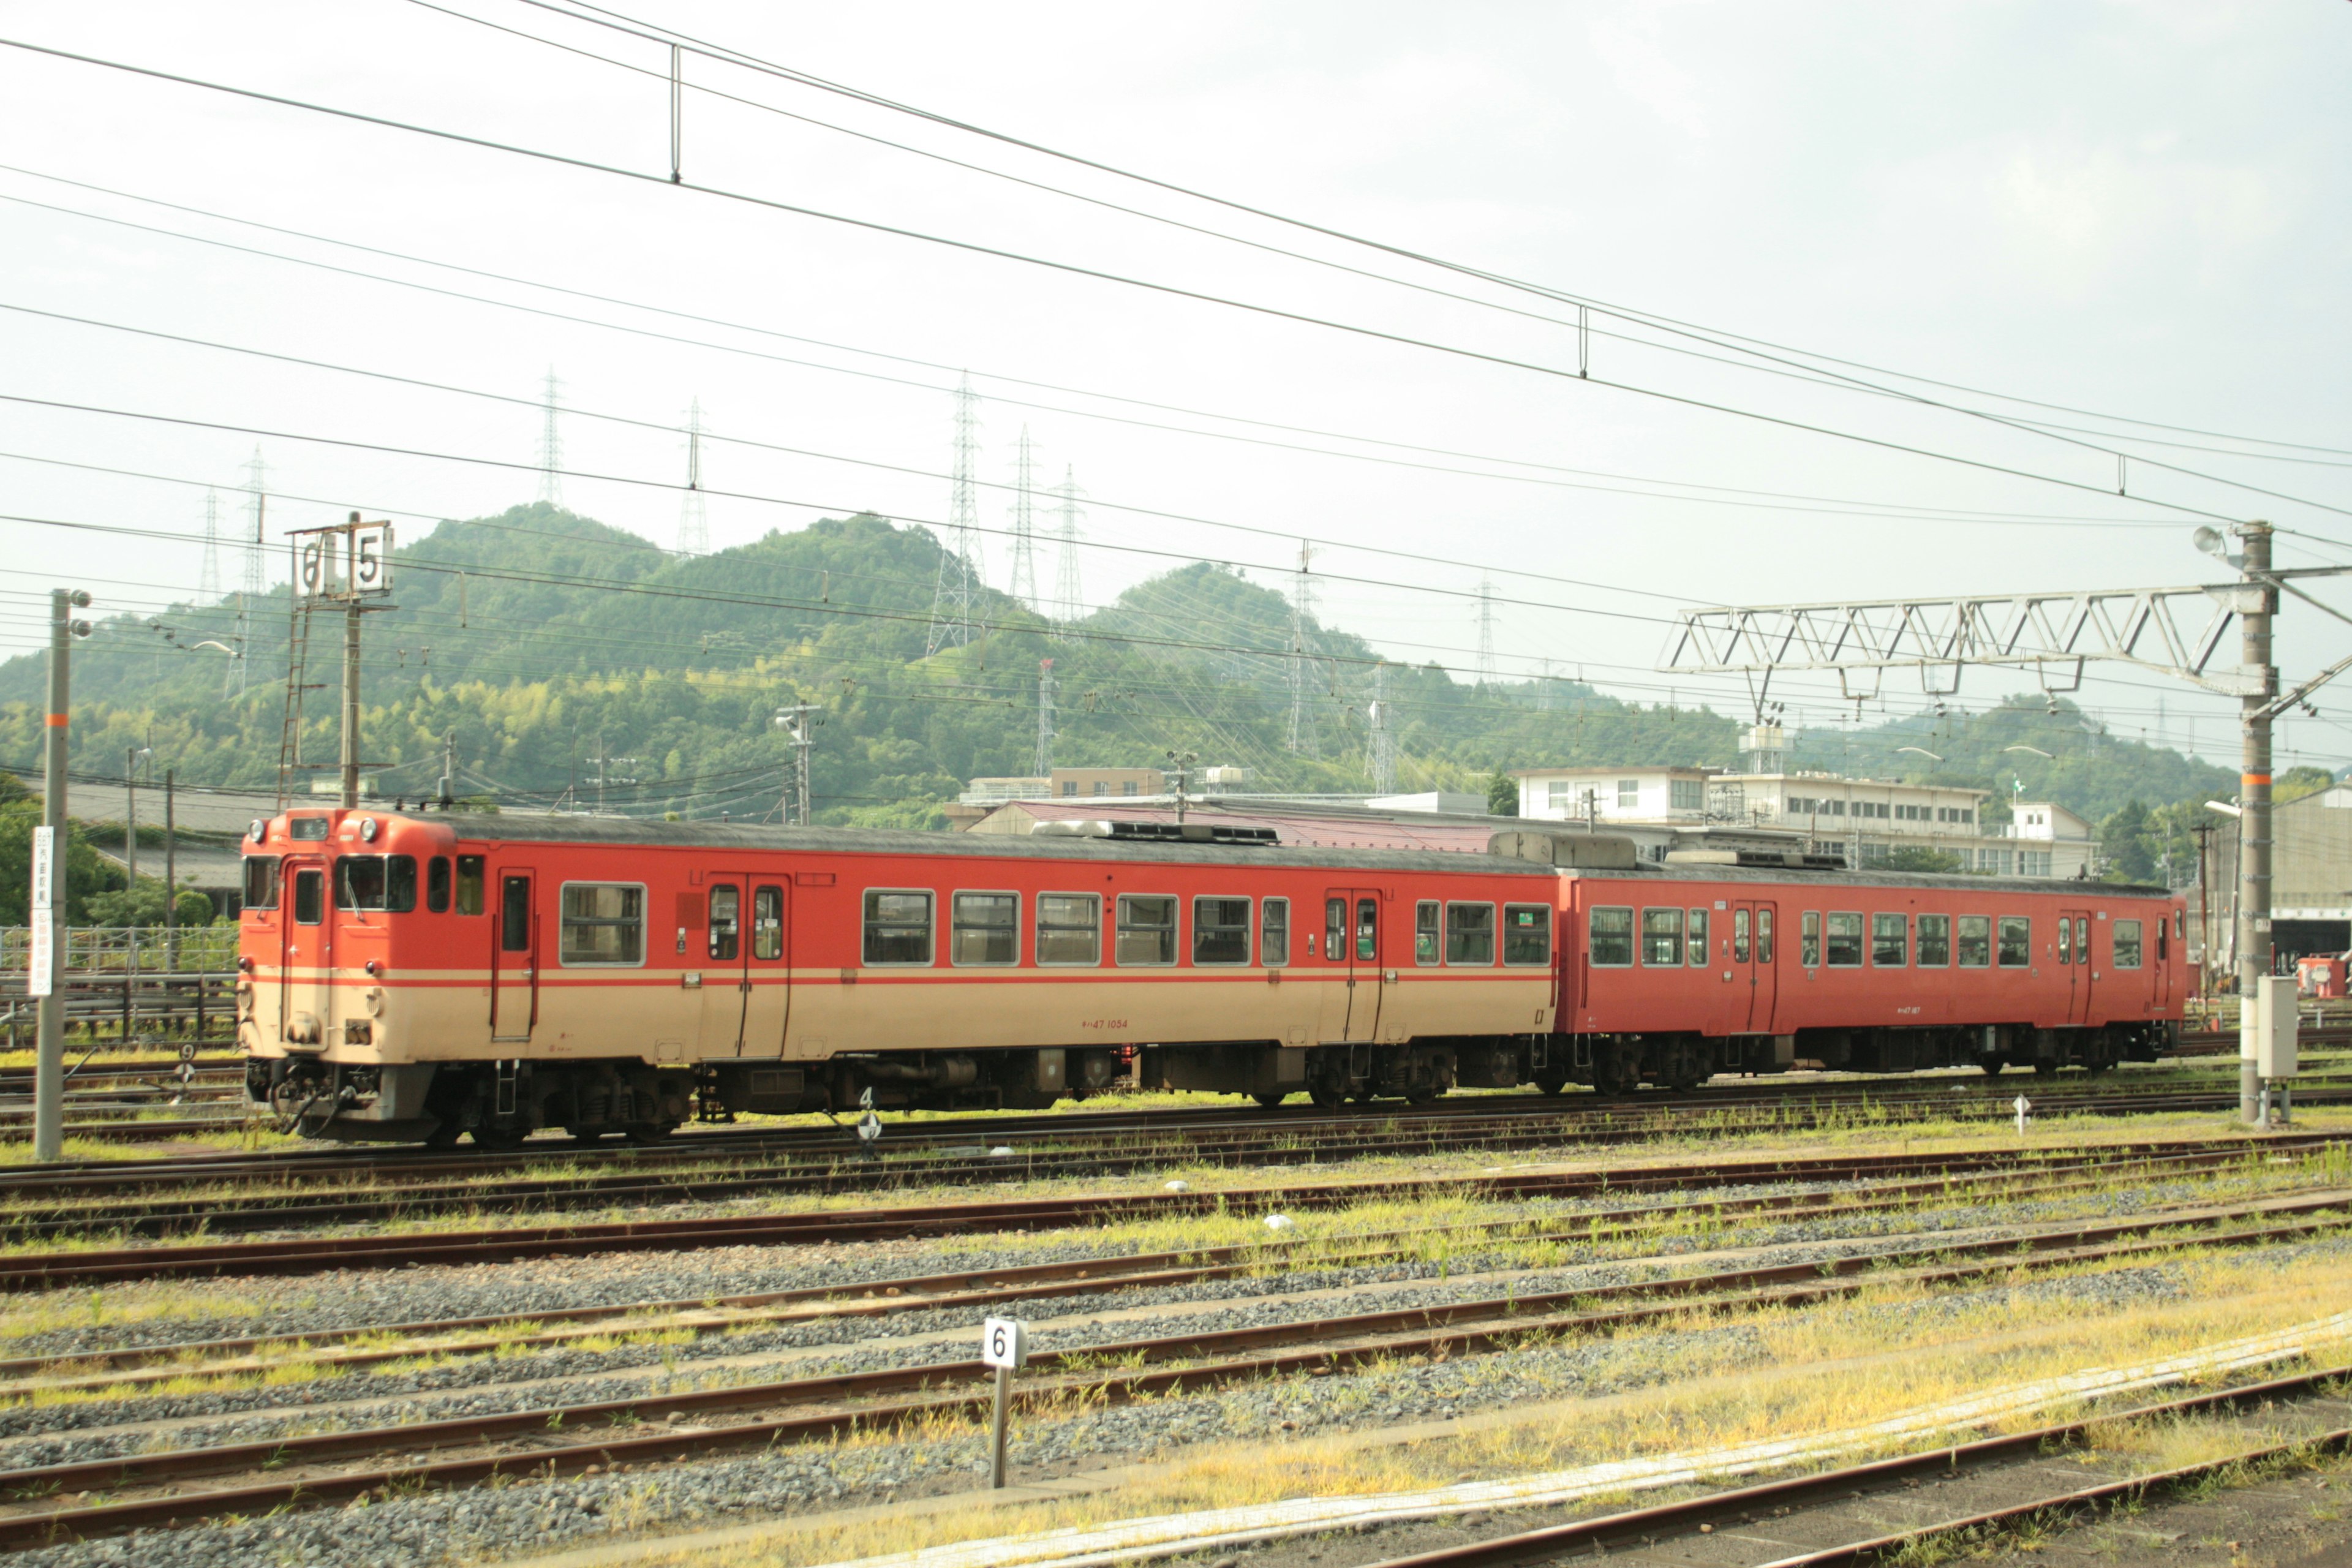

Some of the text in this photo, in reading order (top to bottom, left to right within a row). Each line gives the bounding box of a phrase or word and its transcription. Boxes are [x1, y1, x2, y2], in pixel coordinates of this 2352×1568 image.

[303, 543, 320, 589] 6
[360, 535, 378, 582] 5
[304, 823, 328, 834] 米子
[1082, 1019, 1128, 1029] キハ47 1054
[182, 1044, 194, 1060] 9
[859, 1087, 873, 1110] 4
[993, 1326, 1006, 1357] 6
